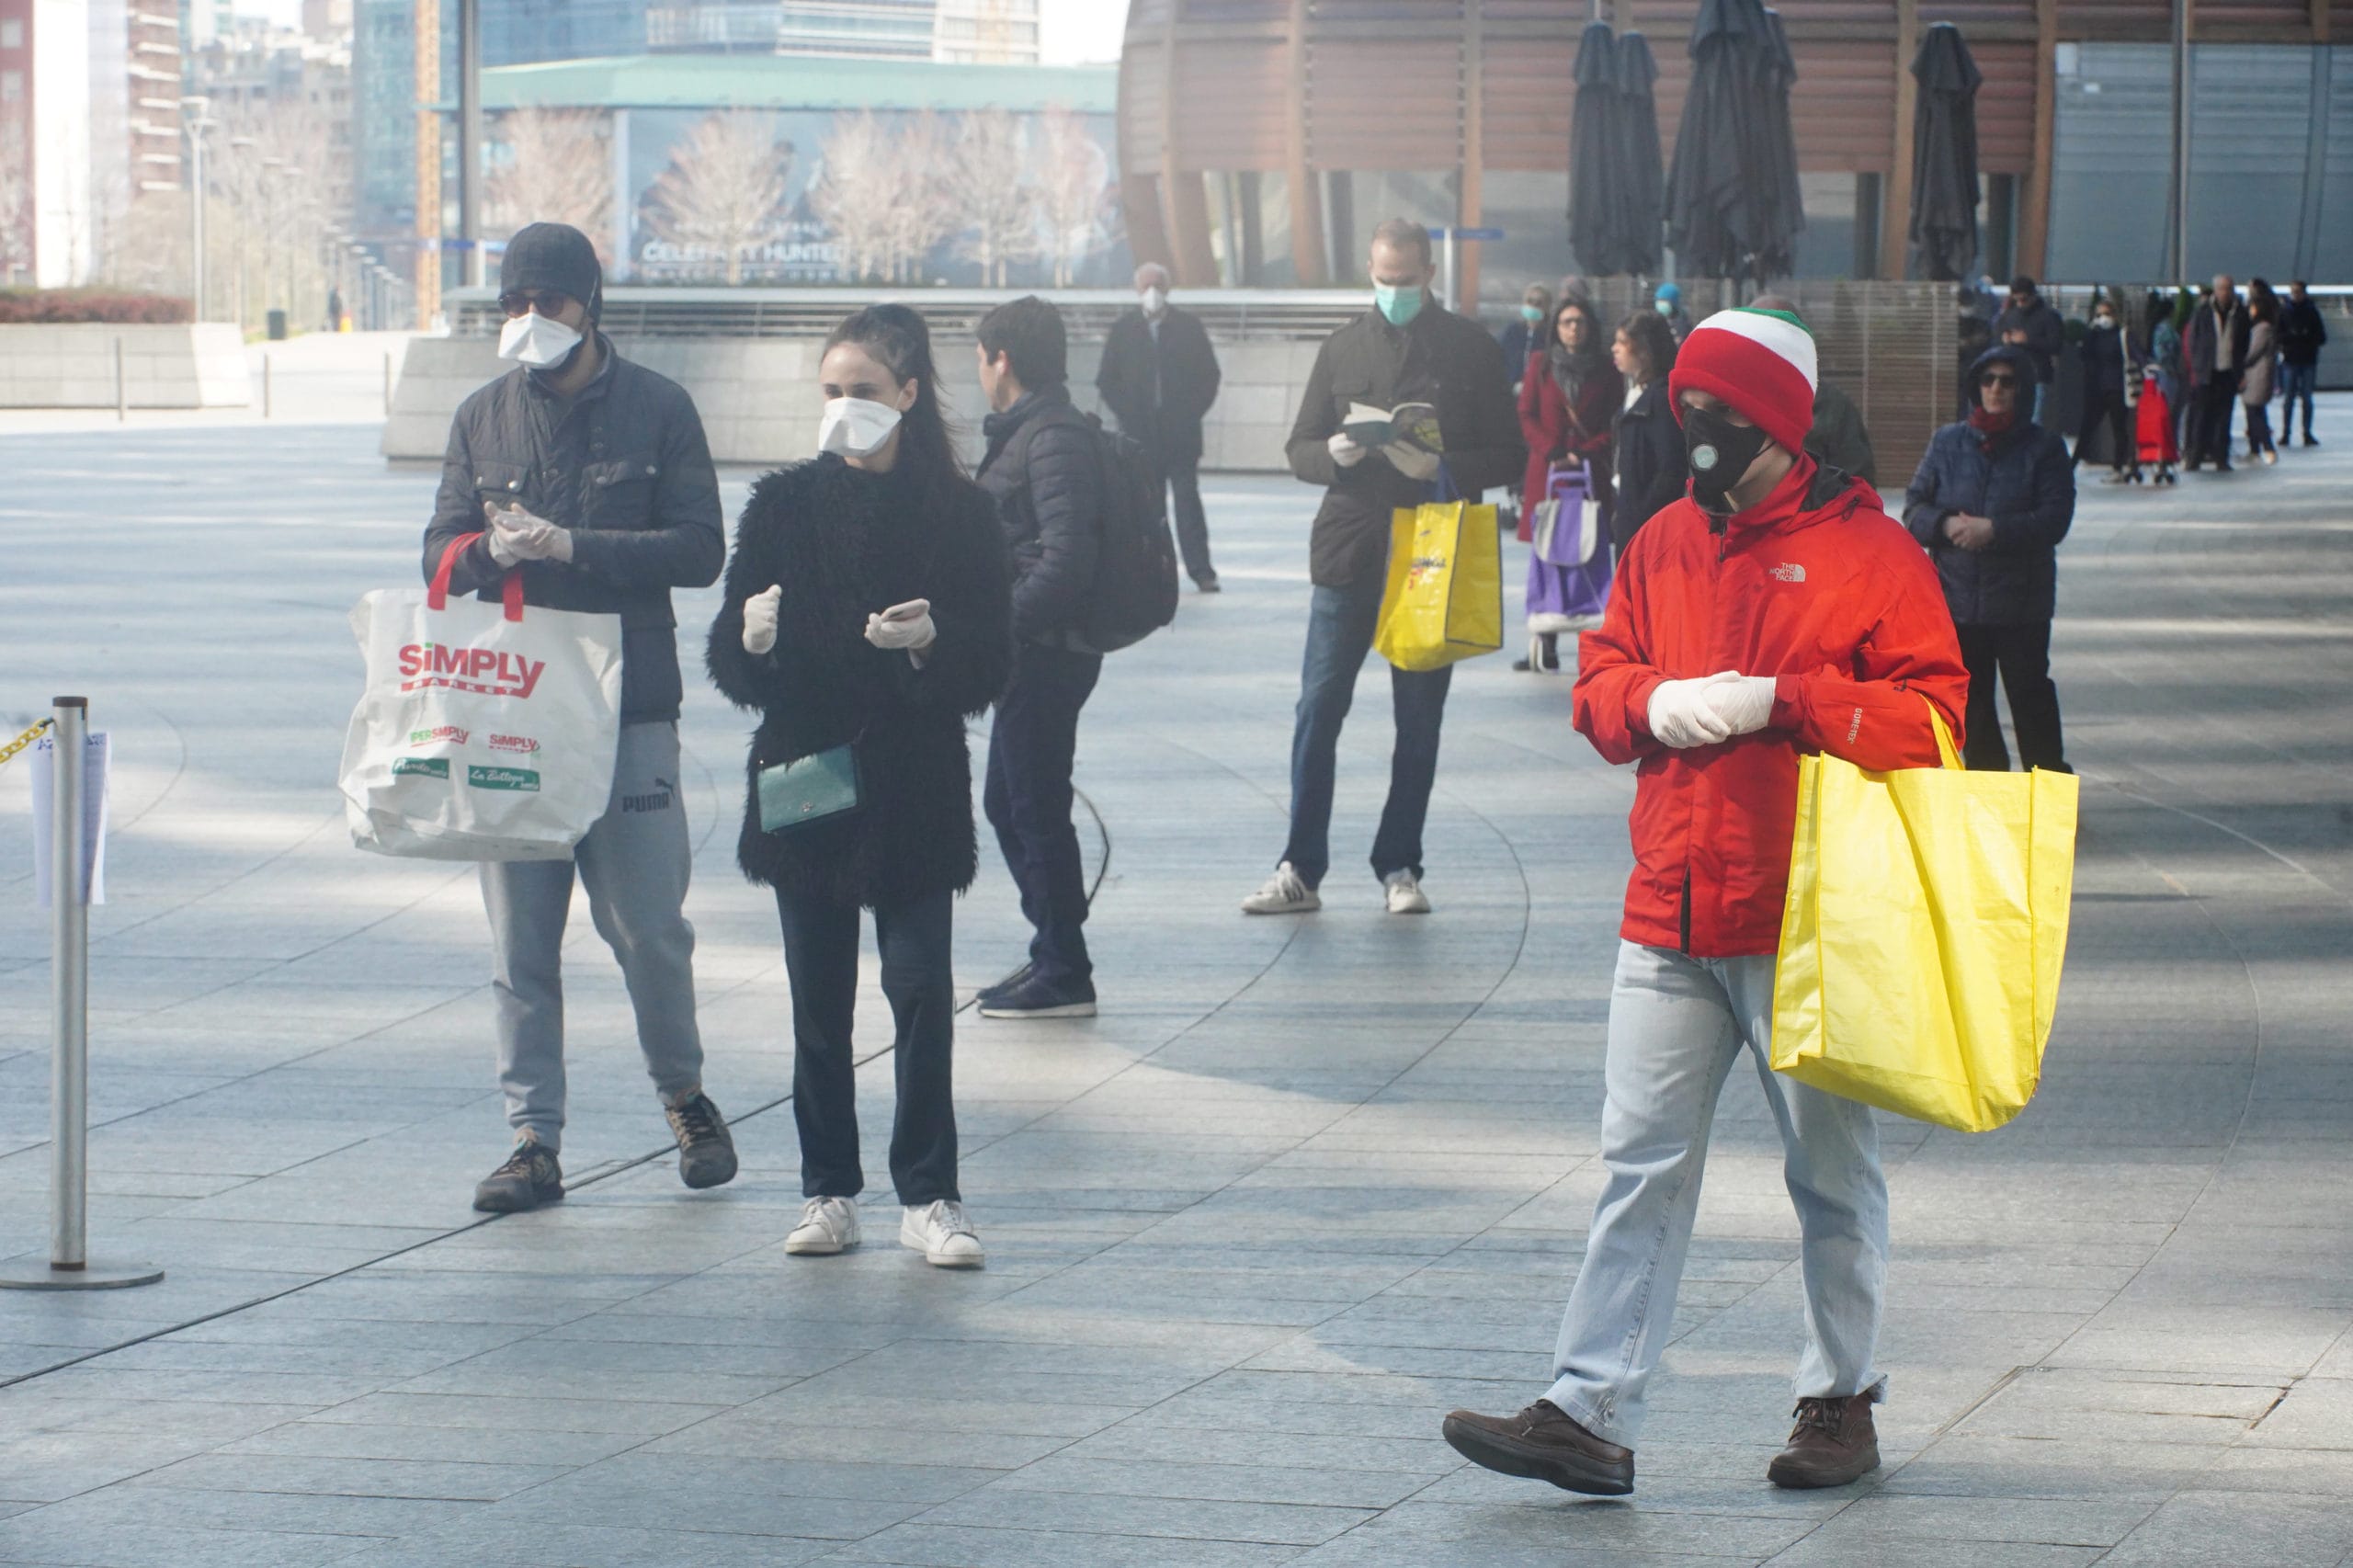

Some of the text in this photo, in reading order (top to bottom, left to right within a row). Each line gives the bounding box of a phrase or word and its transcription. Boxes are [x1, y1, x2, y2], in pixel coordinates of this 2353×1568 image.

[1780, 562, 1795, 571] THE
[1769, 567, 1795, 577] NORTH
[1776, 573, 1794, 582] FACE
[622, 791, 670, 812] PUMA
